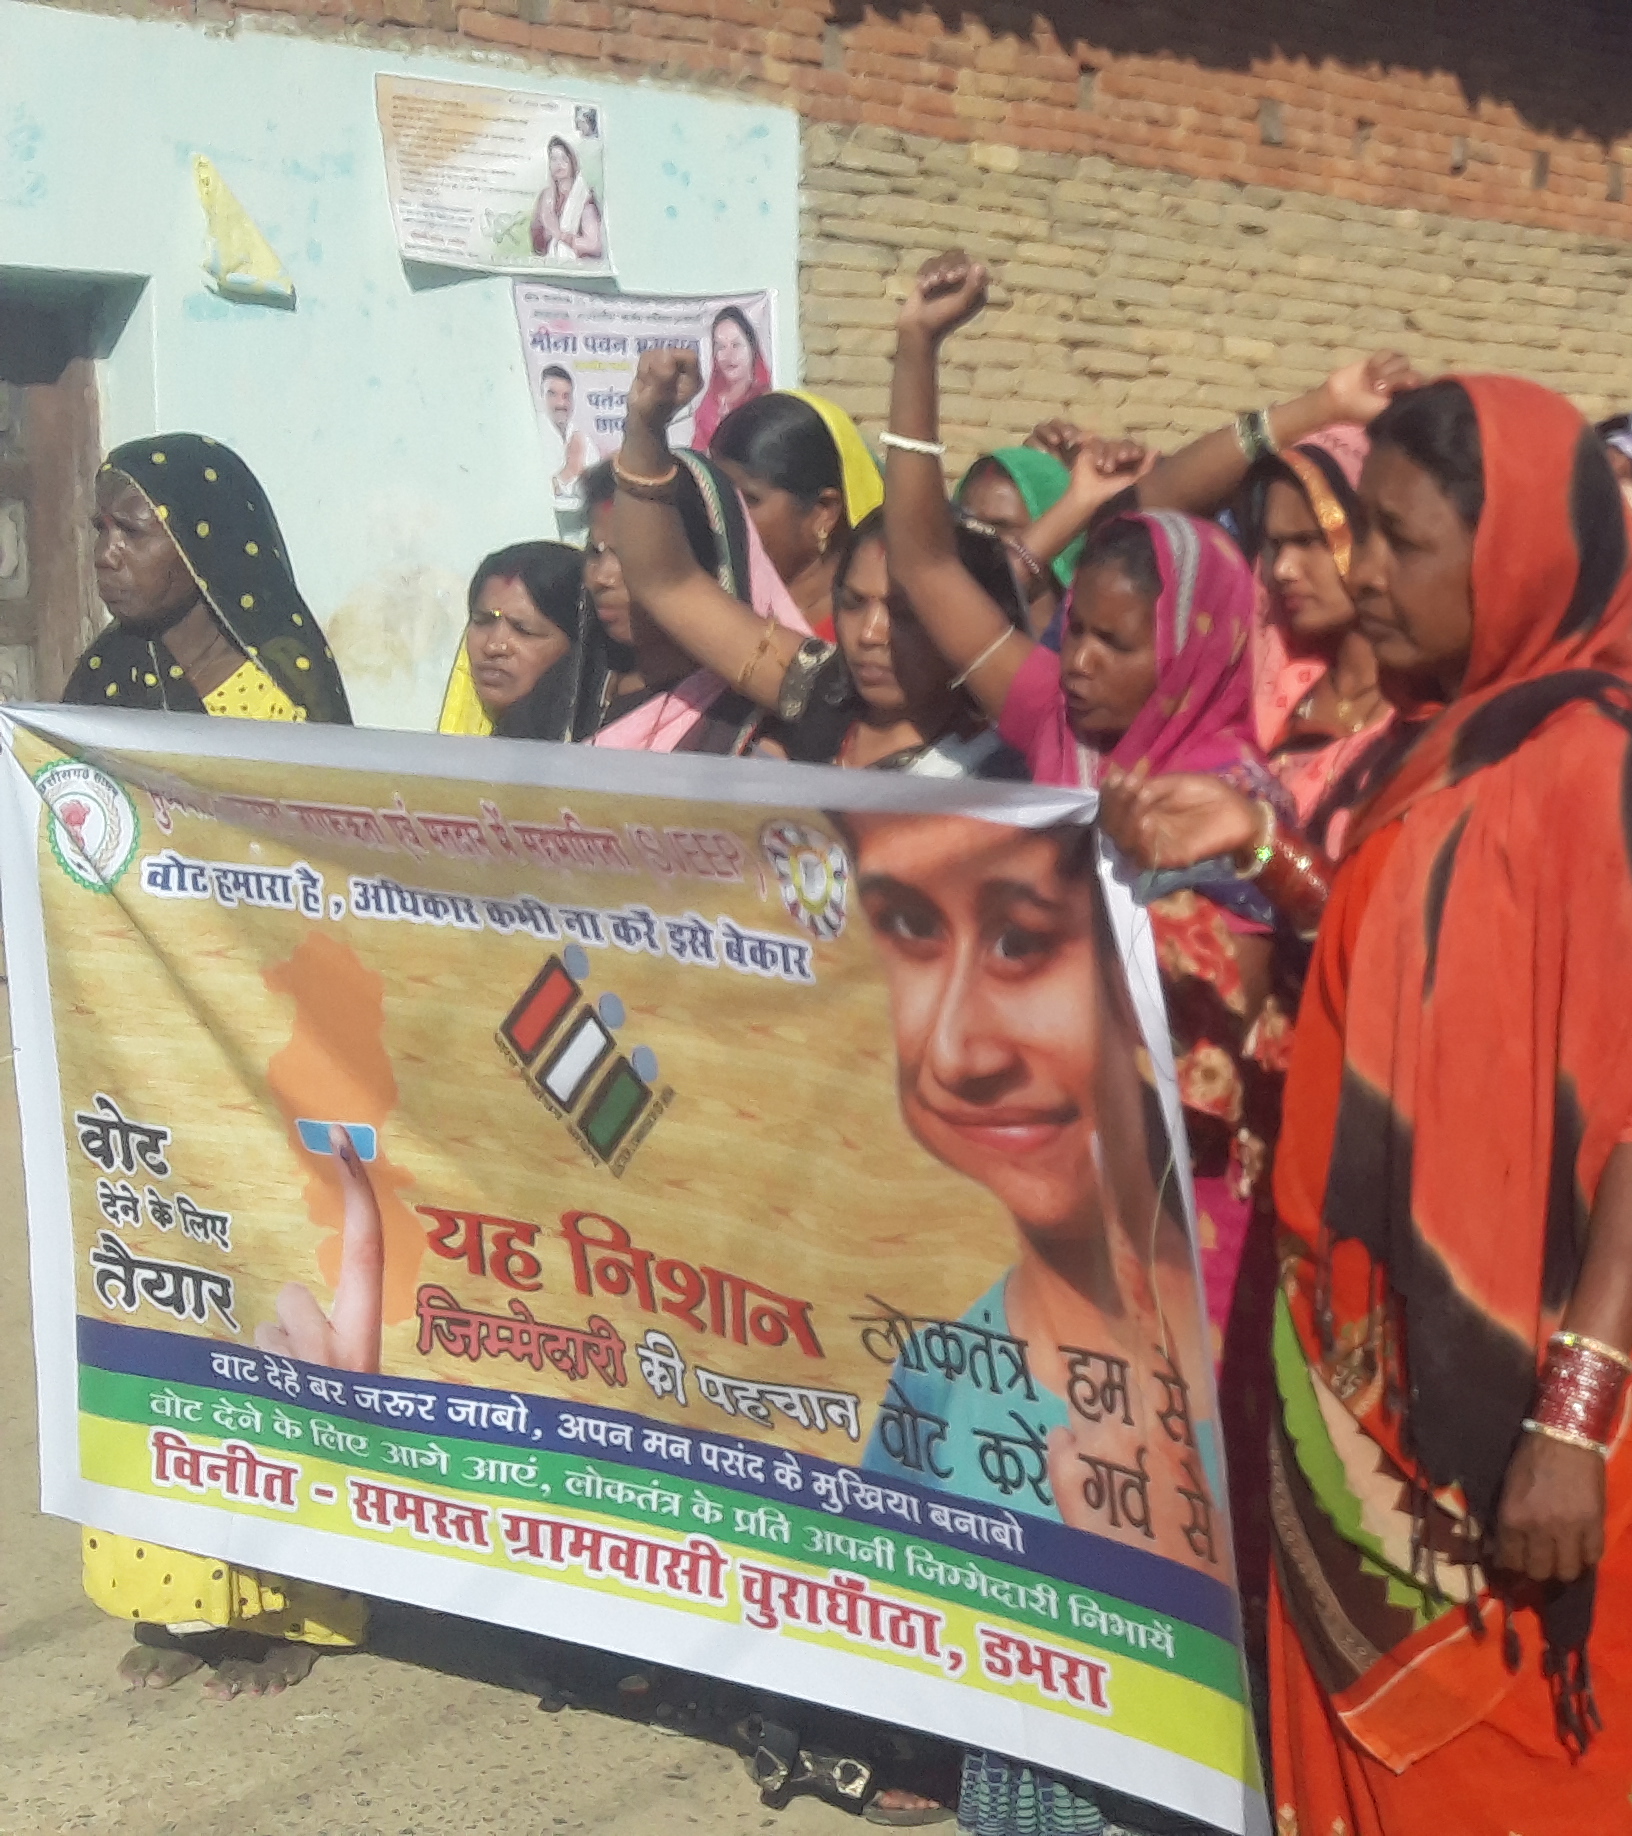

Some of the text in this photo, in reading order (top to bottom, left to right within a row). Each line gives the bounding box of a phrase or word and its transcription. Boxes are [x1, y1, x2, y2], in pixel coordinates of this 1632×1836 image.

[146, 854, 209, 893] वोट
[212, 866, 295, 906] हमारा
[353, 879, 479, 926] अधिकार
[487, 901, 556, 935] कभी
[561, 908, 603, 943] ना
[666, 917, 717, 961] इसे
[722, 923, 811, 979] बेकार
[77, 1096, 169, 1175] वोट
[93, 1232, 238, 1330] तैयार
[100, 1180, 230, 1249] देने के लिए
[415, 1204, 826, 1359] यह निशान
[416, 1283, 861, 1441] जिम्मेदारी की पहचान
[850, 1293, 1194, 1448] लोकतंत्र हम से
[150, 1386, 204, 1423] वोट
[211, 1396, 263, 1434] देने
[271, 1408, 303, 1441] के
[310, 1418, 370, 1456] लिए
[380, 1441, 451, 1476] आगे
[461, 1454, 552, 1498] आएं,
[564, 1464, 684, 1518] लोकतंत्र
[692, 1488, 723, 1525] के
[733, 1506, 792, 1545] प्रति
[803, 1523, 897, 1572] अपनी
[1068, 1592, 1176, 1660] निभायें
[307, 1374, 347, 1406] बर
[447, 1394, 543, 1441] जाबो,
[558, 1412, 634, 1453] अपन
[643, 1428, 693, 1466] मन
[701, 1441, 766, 1484] पसंद
[773, 1450, 804, 1492] के
[810, 1467, 922, 1525] मुखिया
[927, 1499, 1027, 1555] बनाबो
[879, 1379, 1218, 1564] वोट करें गर्व से
[150, 1430, 299, 1507] विनीत
[349, 1480, 490, 1548] समस्त
[500, 1512, 730, 1601] ग्रामवासी
[979, 1627, 1110, 1711] डभरा
